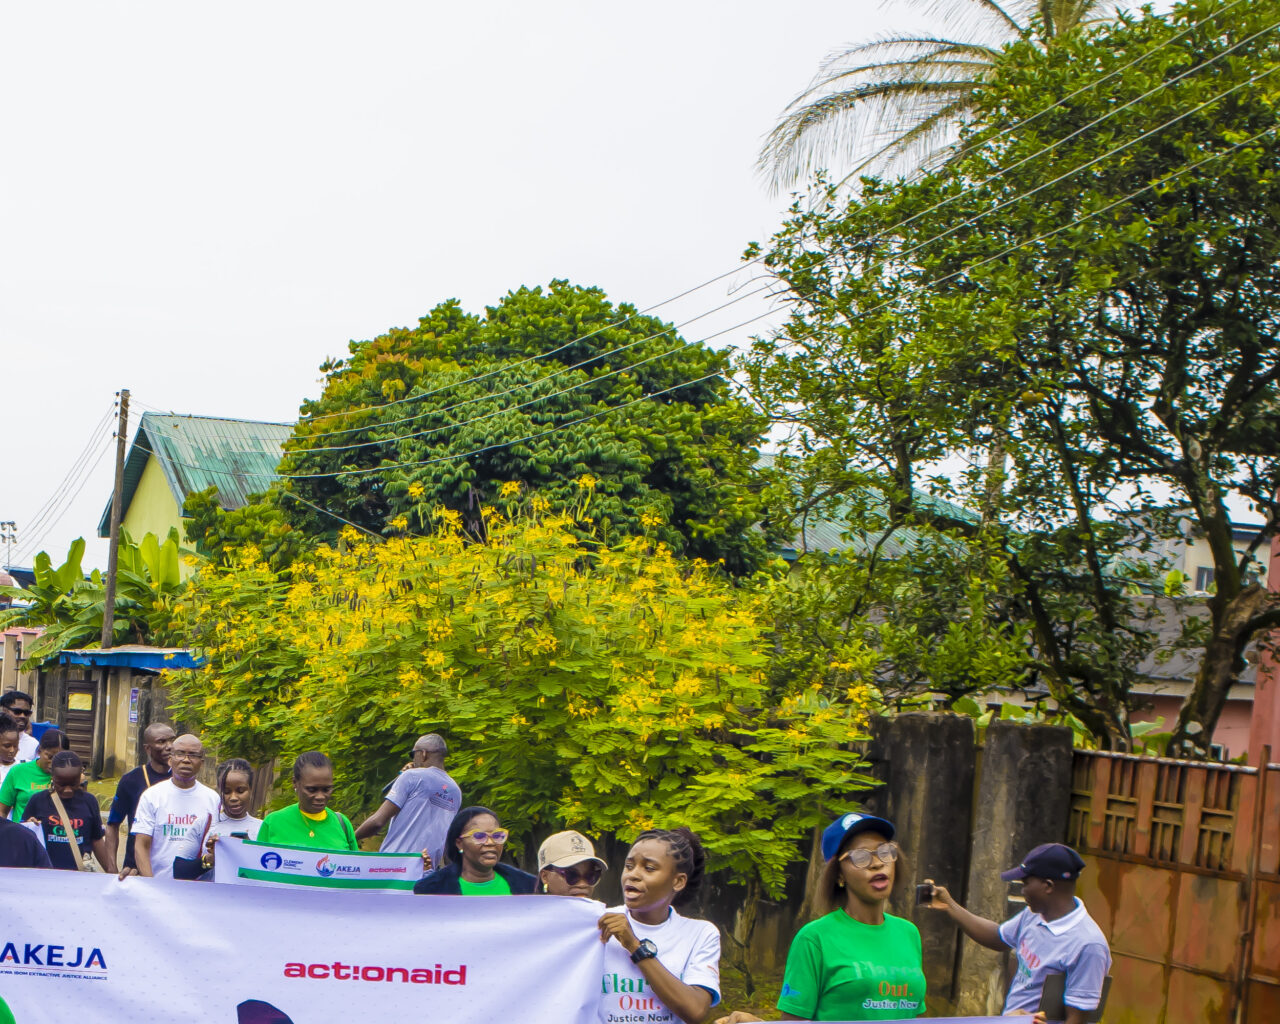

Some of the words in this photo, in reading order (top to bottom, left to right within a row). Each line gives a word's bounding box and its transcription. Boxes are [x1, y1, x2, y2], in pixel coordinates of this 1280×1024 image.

[168, 813, 190, 825] End
[336, 865, 361, 873] AKEJA
[601, 973, 650, 994] Flar
[878, 980, 913, 997] Out.
[619, 994, 661, 1011] Out.
[862, 998, 898, 1009] Justice
[608, 1014, 645, 1023] Justice
[648, 1013, 673, 1022] Now!
